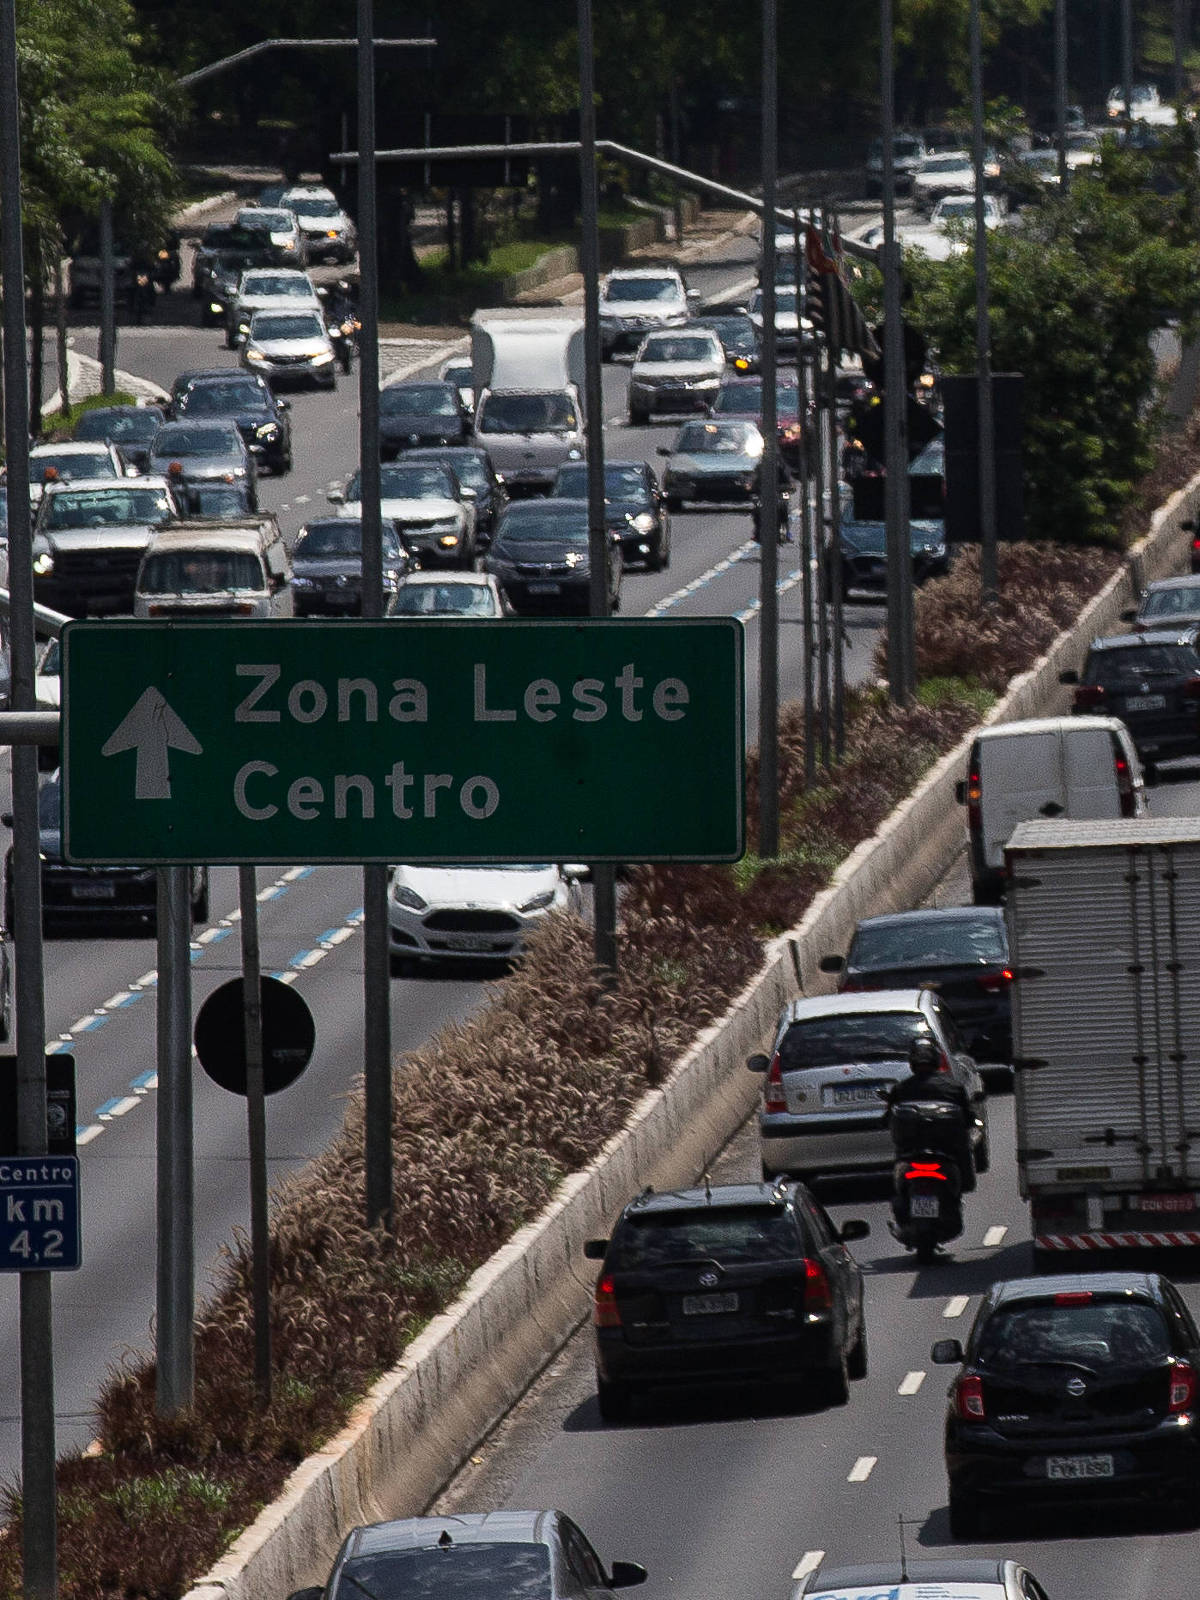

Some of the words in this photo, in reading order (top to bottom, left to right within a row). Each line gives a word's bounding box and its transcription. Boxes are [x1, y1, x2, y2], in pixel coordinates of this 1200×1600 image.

[237, 664, 428, 723] Zona
[475, 663, 690, 722] Leste
[234, 760, 500, 820] Centro
[0, 1166, 72, 1181] Centro
[7, 1195, 64, 1222] km
[10, 1230, 64, 1261] 4,2
